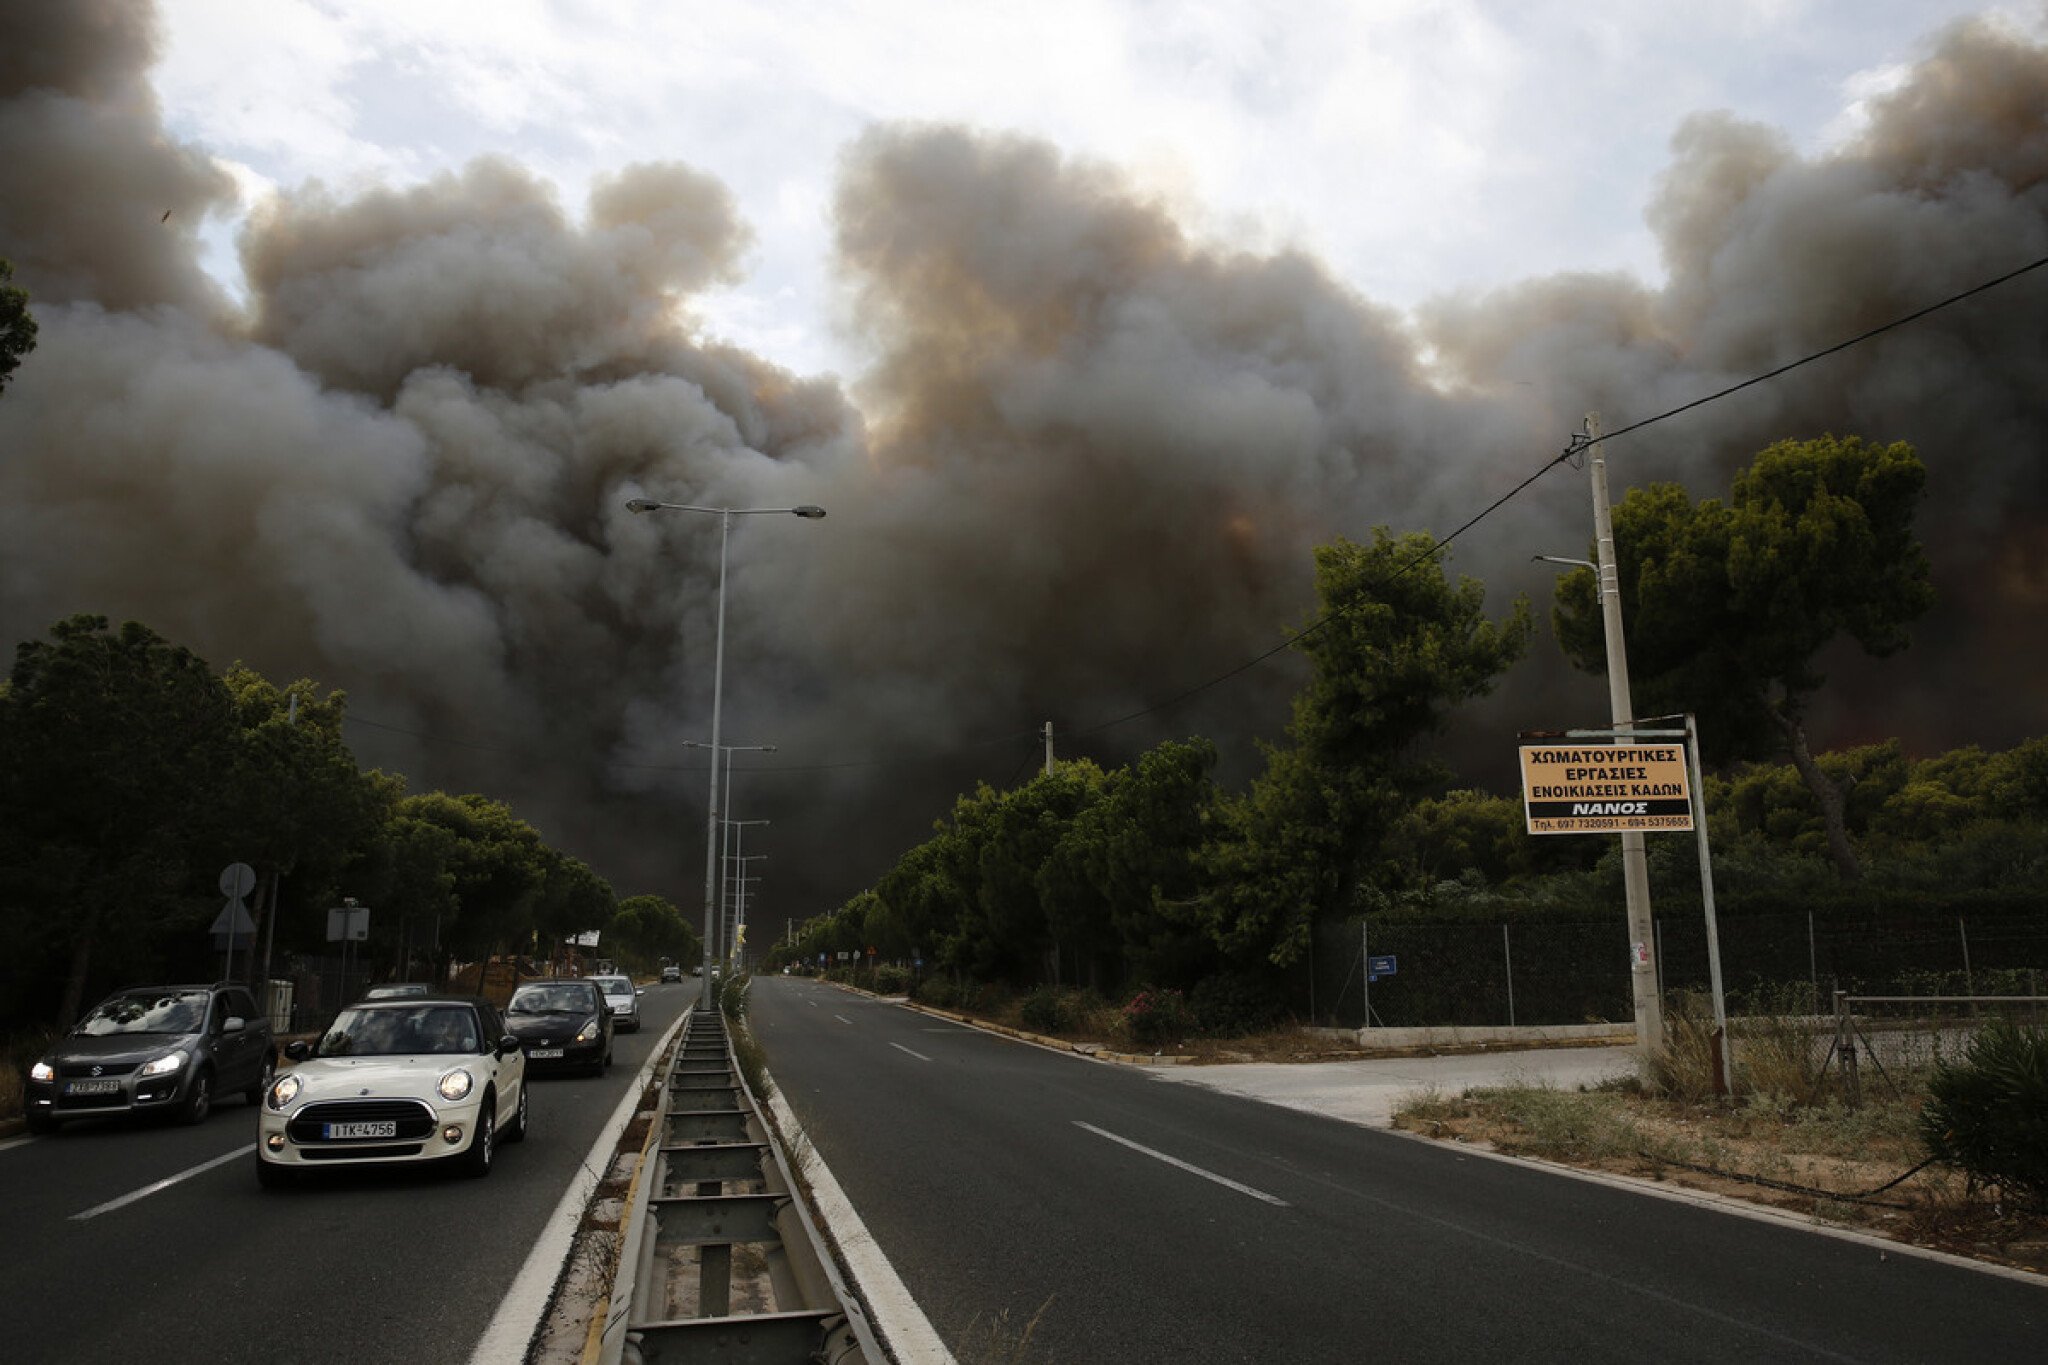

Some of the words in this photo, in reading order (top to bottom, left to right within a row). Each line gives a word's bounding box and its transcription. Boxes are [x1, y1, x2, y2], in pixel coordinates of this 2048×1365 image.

[1531, 750, 1677, 763] ΧΩΜΑΤΟΥΡΓΙΚΕΣ
[1565, 767, 1648, 780] ΕΡΓΑΣΙΕΣ
[1532, 785, 1628, 798] ΕΝΟΙΚΙΑΣΕΙΣ
[1631, 783, 1682, 796] ΚΑΔΩΝ
[1572, 802, 1648, 815] ΝΑΝΟΣ
